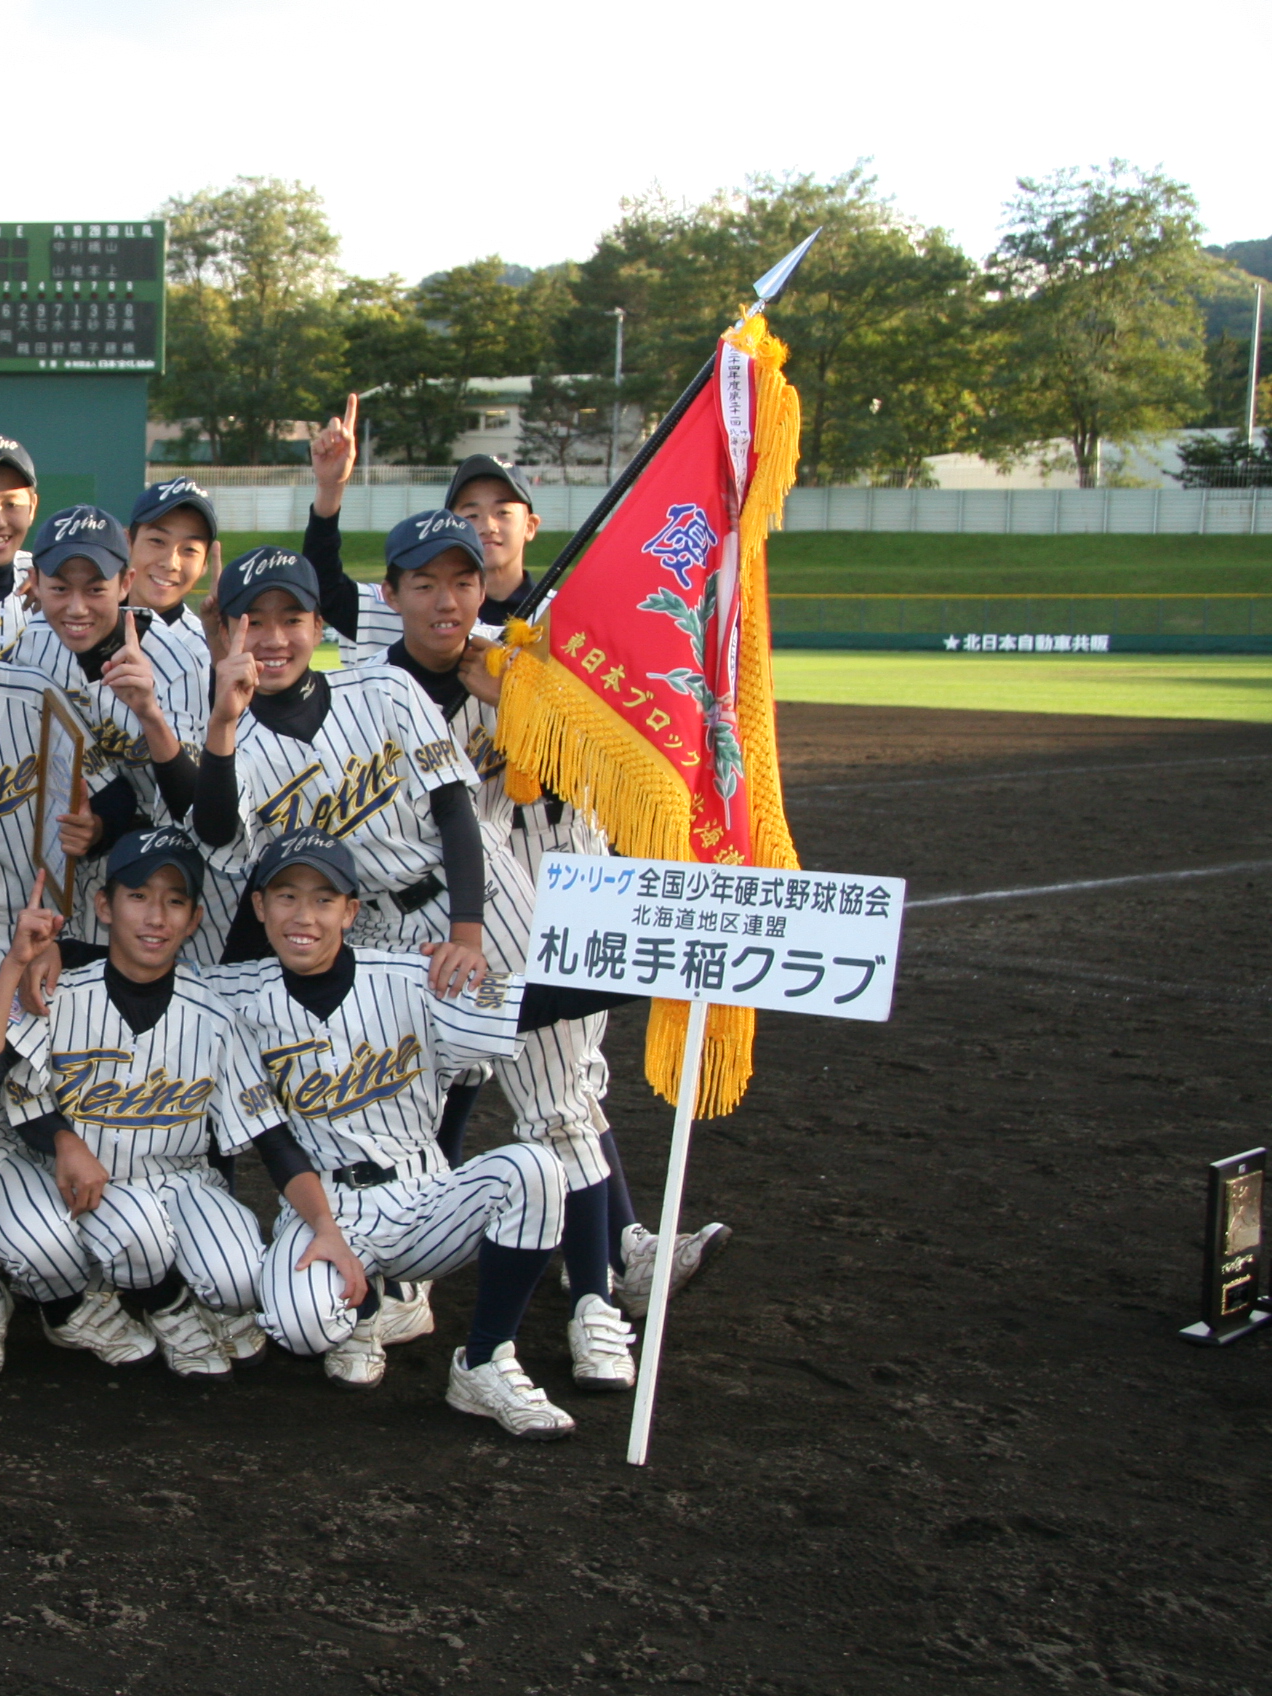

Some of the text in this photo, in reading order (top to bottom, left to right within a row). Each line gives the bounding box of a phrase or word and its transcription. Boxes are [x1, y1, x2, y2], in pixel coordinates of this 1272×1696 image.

[17, 226, 24, 237] E
[54, 507, 107, 541] Teine
[642, 503, 716, 589] 優
[239, 546, 298, 585] Teine
[559, 631, 702, 769] 東日本ブロック
[631, 903, 788, 939] 北海道地区連盟
[637, 866, 892, 919] 全国少年硬式野球協会
[536, 926, 887, 1005] 札幌手稲クラブ
[51, 1047, 215, 1131] Teine
[261, 1033, 427, 1121] Teine
